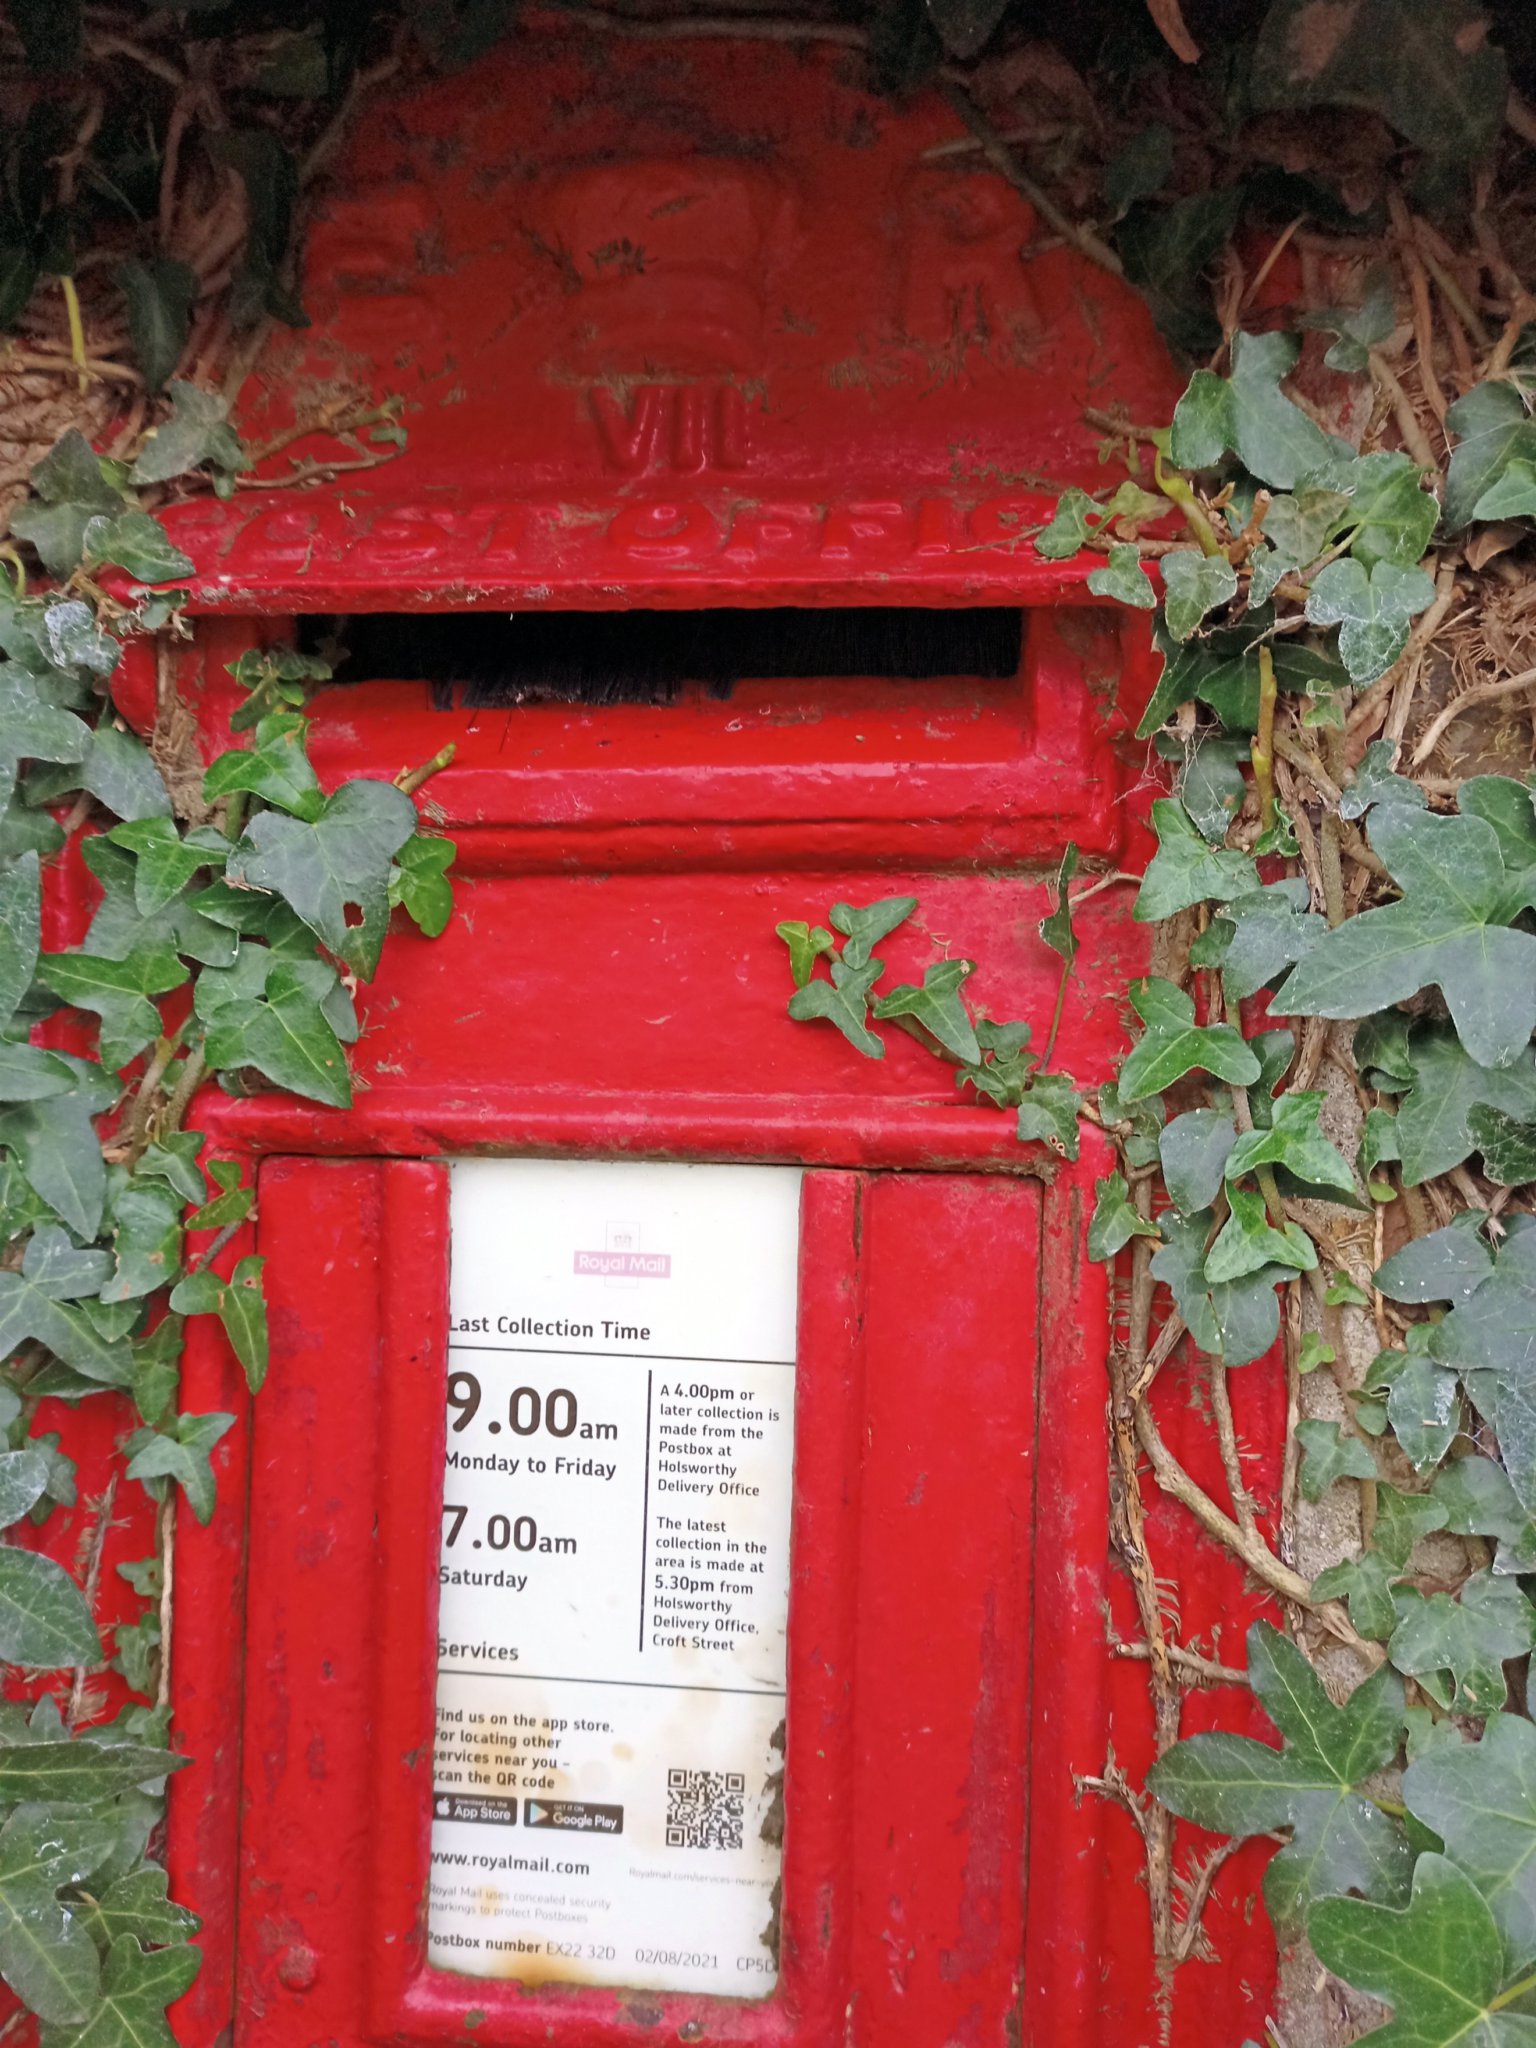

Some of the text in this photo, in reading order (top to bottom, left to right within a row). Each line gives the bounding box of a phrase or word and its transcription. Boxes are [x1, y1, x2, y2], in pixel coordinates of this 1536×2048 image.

[605, 494, 1100, 564] OFFIC
[579, 1254, 667, 1274] Royal Mail
[449, 1313, 651, 1341] Last Collection Time
[660, 1382, 755, 1402] A 4.00pm or
[446, 1371, 619, 1441] 9.00am
[660, 1403, 780, 1421] later collection is
[659, 1423, 763, 1439] made from the
[659, 1440, 732, 1457] Postbox at
[444, 1451, 617, 1482] Monday to Friday
[658, 1459, 737, 1478] Holsworthy
[658, 1478, 760, 1496] Delivery Office
[442, 1504, 578, 1555] 7.00am
[657, 1516, 727, 1532] The latest
[655, 1536, 767, 1554] collection in the
[655, 1556, 764, 1573] area is made at
[439, 1565, 528, 1593] Saturday
[654, 1574, 753, 1594] 5.30pm from
[654, 1595, 732, 1615] Holsworthy
[653, 1614, 709, 1633] Delivery
[438, 1638, 520, 1661] Services
[652, 1633, 734, 1651] Croft Street
[468, 1713, 485, 1724] us
[490, 1714, 508, 1725] on
[513, 1713, 536, 1727] the
[542, 1718, 568, 1732] app
[573, 1720, 614, 1733] store.
[460, 1729, 517, 1749] locating
[522, 1736, 562, 1749] other
[495, 1754, 527, 1767] near
[532, 1758, 557, 1770] you
[468, 1770, 491, 1785] the
[496, 1771, 517, 1786] QR
[522, 1776, 555, 1789] code
[454, 1805, 511, 1820] App Store
[553, 1803, 567, 1811] GET
[552, 1811, 617, 1831] Google Play
[431, 1852, 590, 1875] www.royalmail.com
[460, 1886, 482, 1899] Mail
[485, 1891, 510, 1900] uses
[513, 1893, 566, 1905] concealed
[569, 1896, 611, 1910] security
[480, 1905, 490, 1915] to
[494, 1907, 530, 1918] protect
[535, 1908, 588, 1923] Postboxes
[486, 1939, 541, 1954] number
[546, 1941, 582, 1957] EX22
[635, 1948, 718, 1969] 02/08/2021
